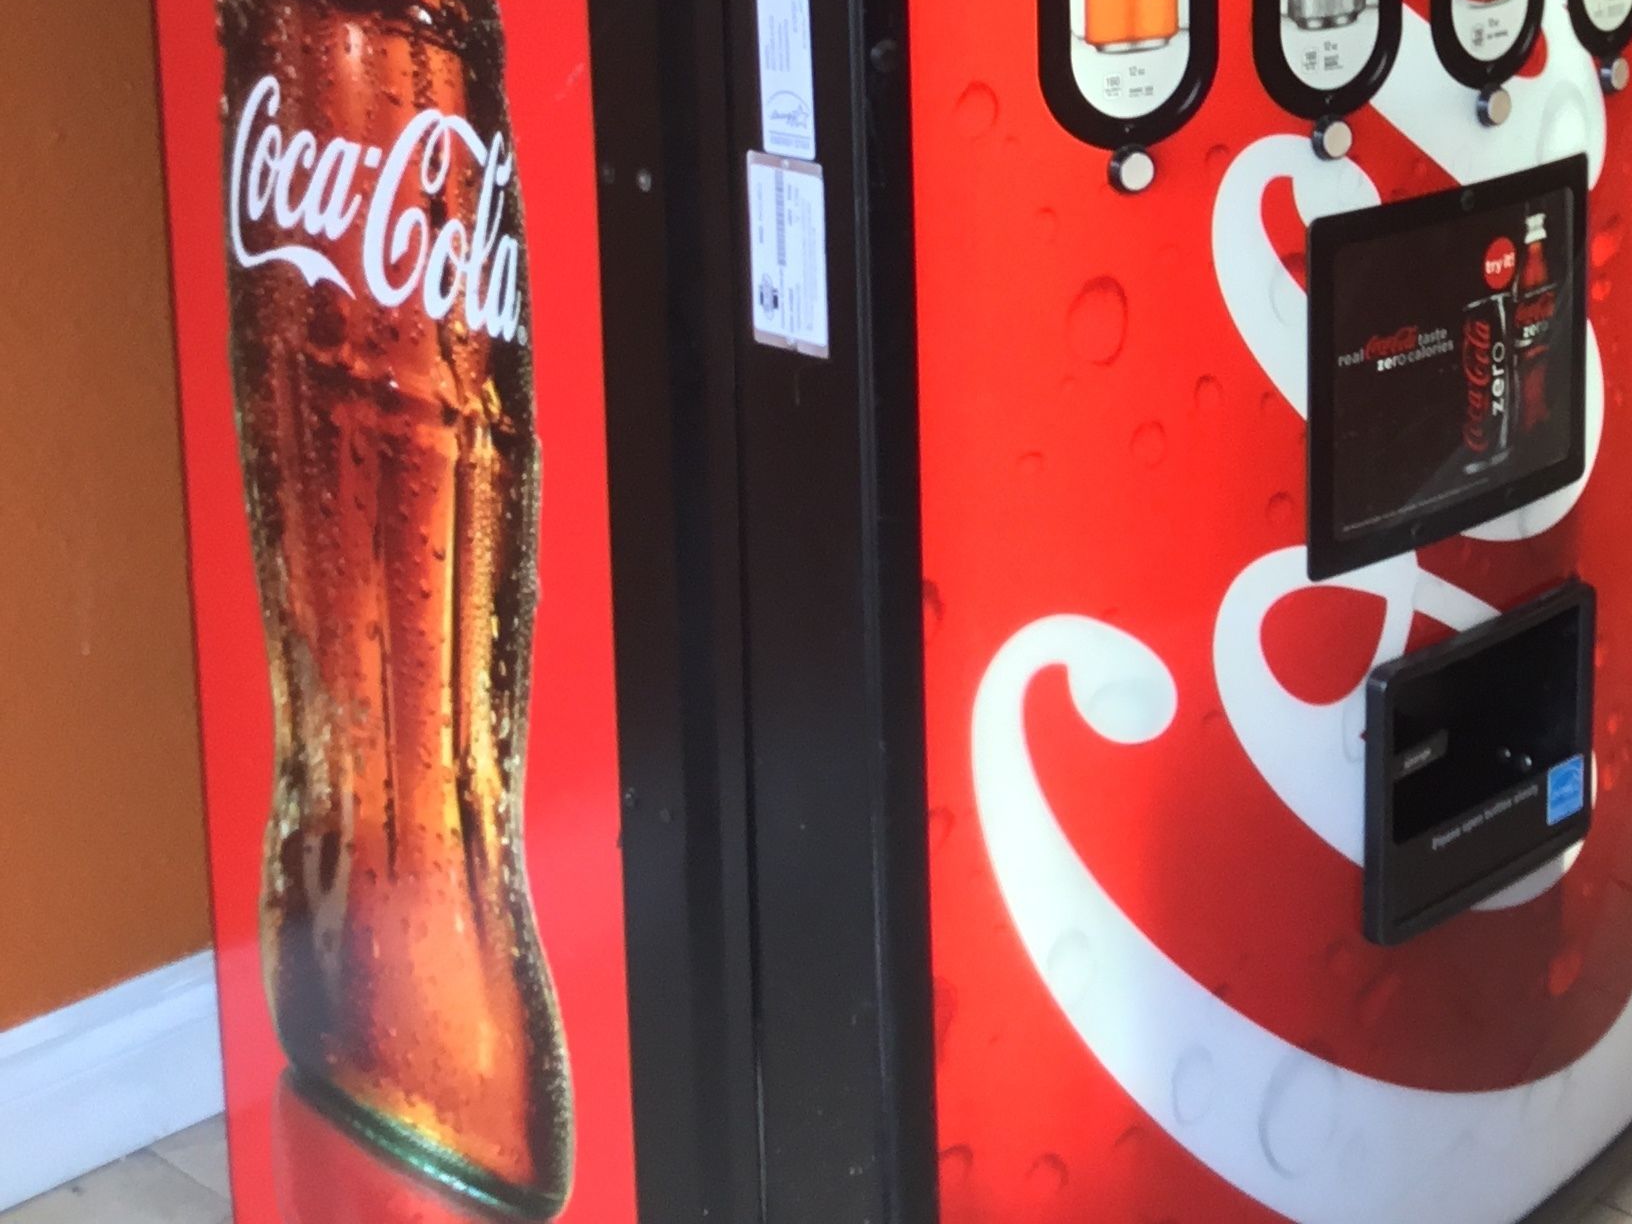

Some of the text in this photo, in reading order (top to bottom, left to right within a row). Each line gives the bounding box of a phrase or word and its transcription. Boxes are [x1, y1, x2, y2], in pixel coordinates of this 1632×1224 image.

[230, 75, 522, 343] Coca-Cola
[1484, 260, 1502, 275] try
[1338, 349, 1365, 367] real
[1418, 328, 1448, 346] taste
[1377, 340, 1454, 372] zero calories
[1492, 342, 1506, 416] zero
